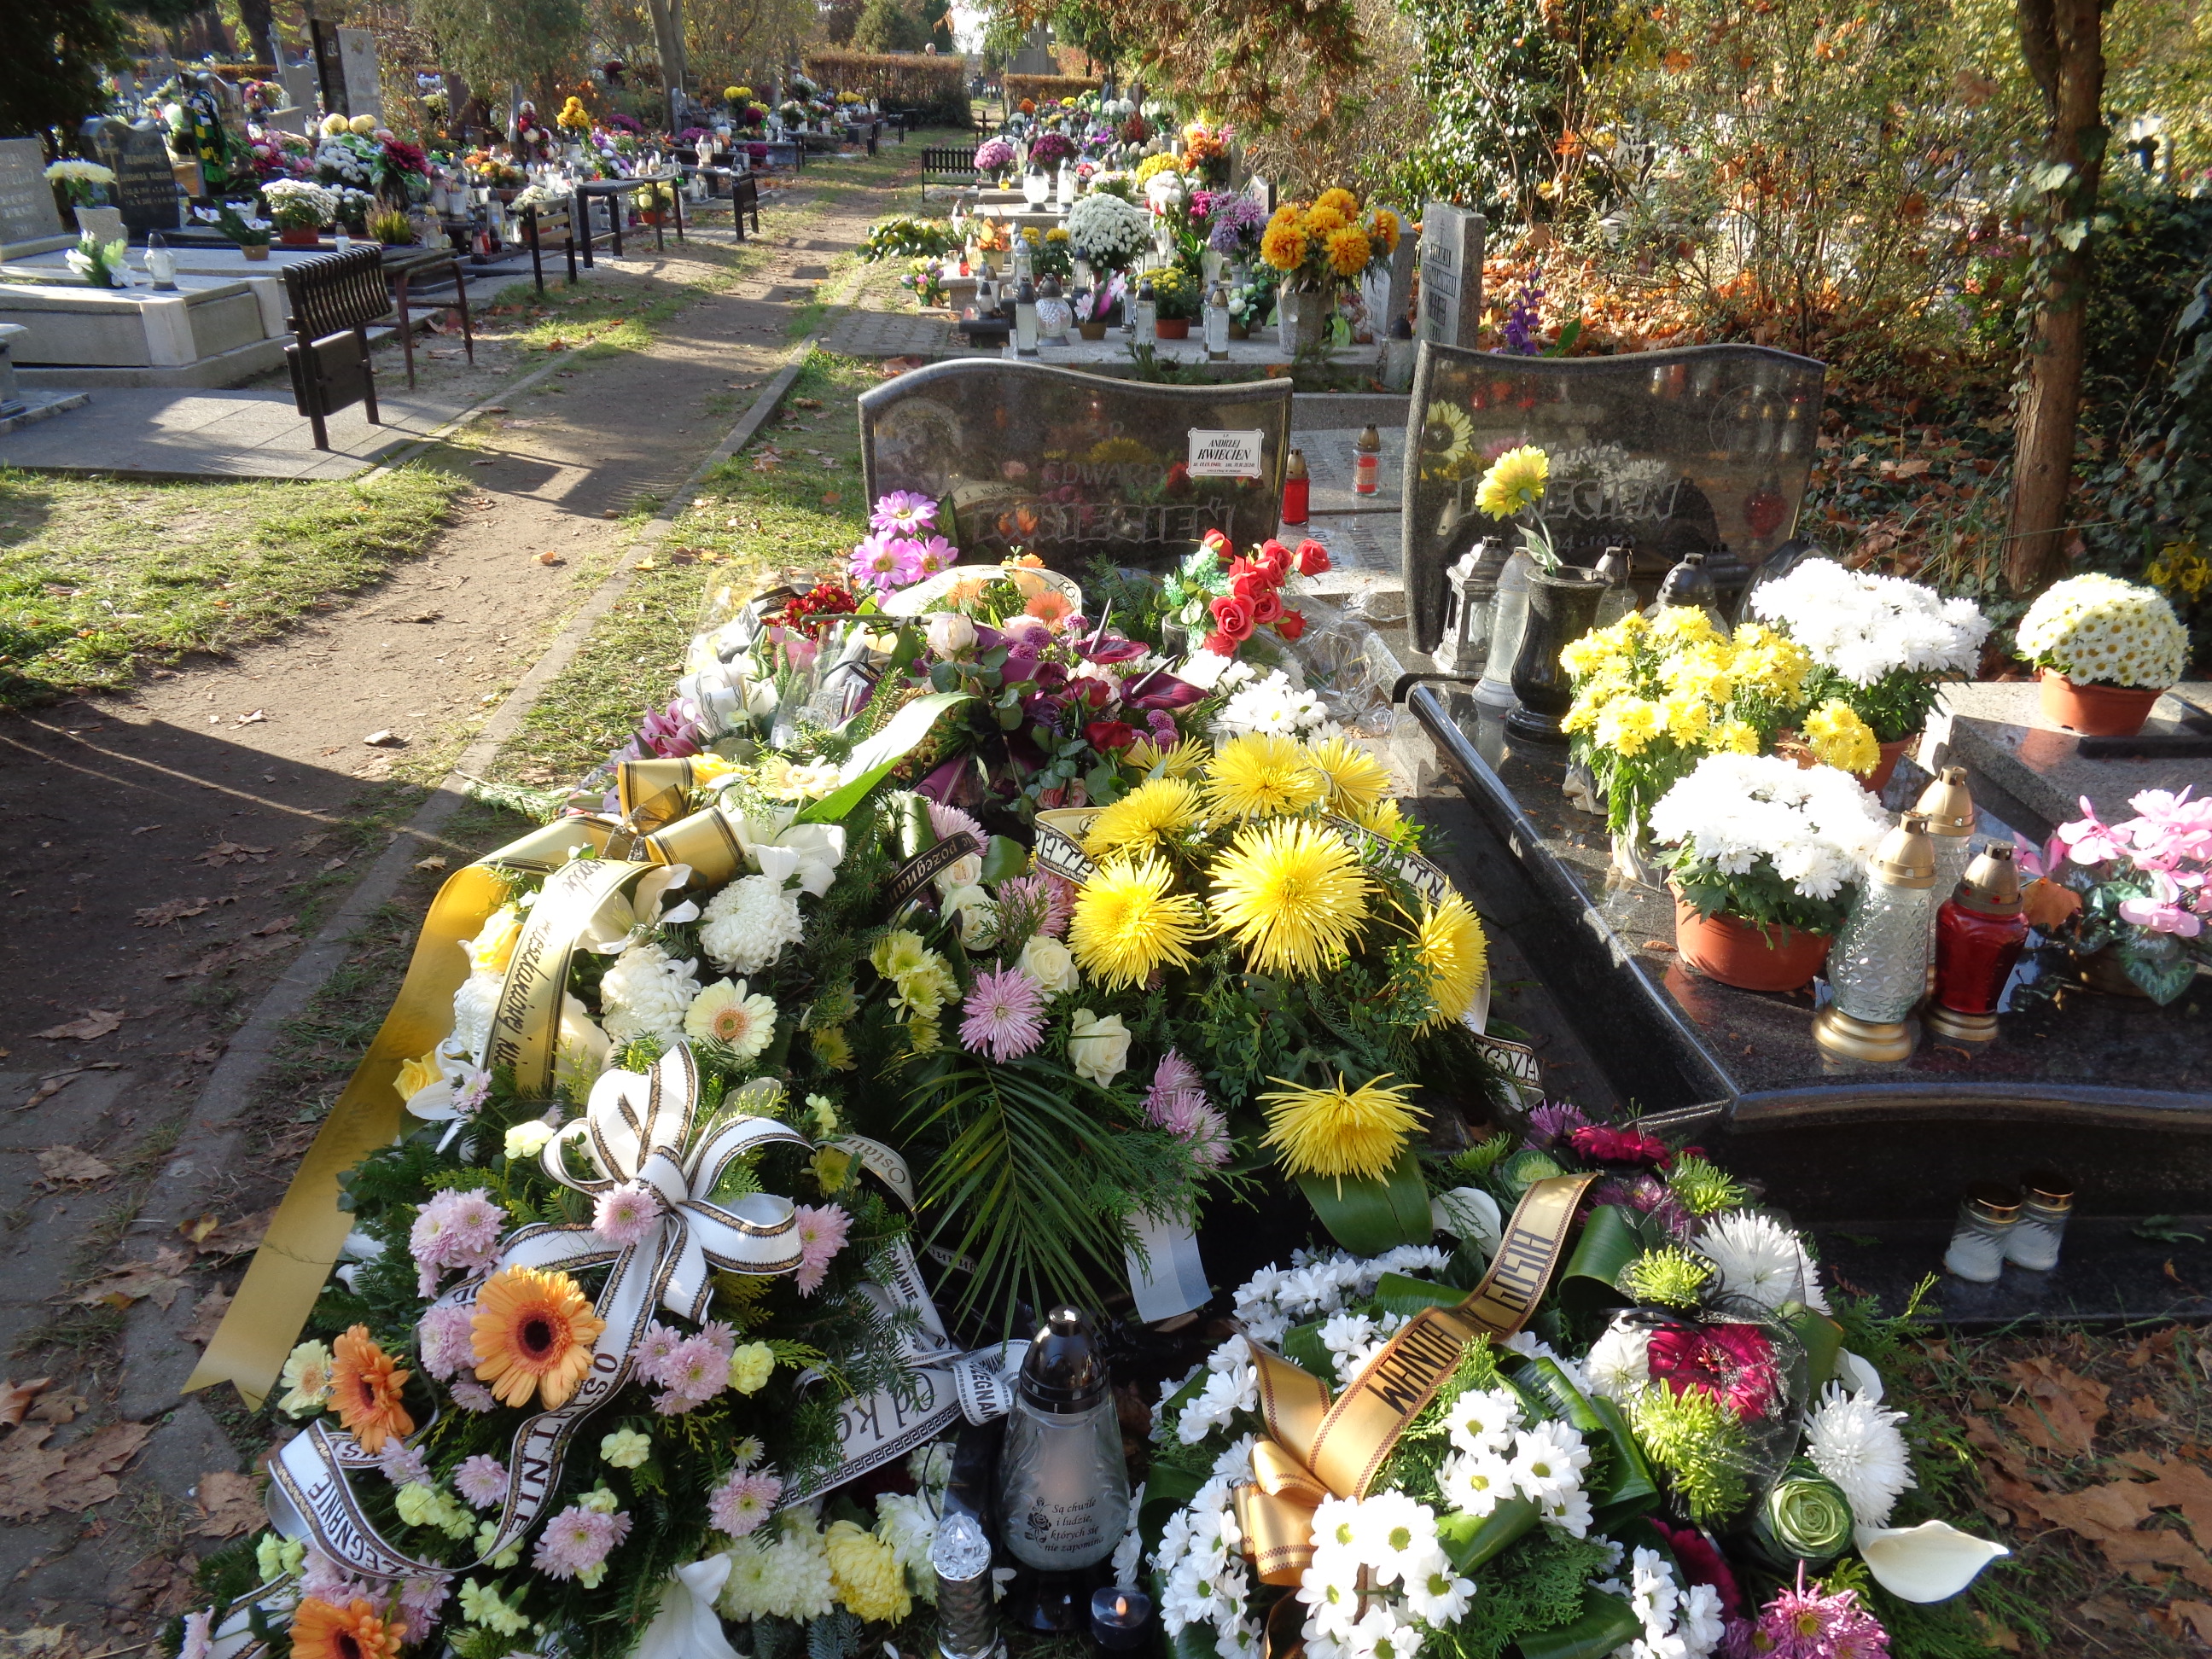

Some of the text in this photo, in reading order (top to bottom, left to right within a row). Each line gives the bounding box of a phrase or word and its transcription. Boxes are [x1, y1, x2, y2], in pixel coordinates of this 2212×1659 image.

[1208, 439, 1241, 449] ANDRZEJ
[1197, 447, 1252, 461] KWIECIEŃ
[1041, 461, 1165, 485] EDWARD
[1365, 1318, 1460, 1417] WANDA
[1481, 1228, 1554, 1314] GOSIA
[512, 1352, 618, 1534] OSTATNIE
[1051, 1496, 1097, 1515] Są chwile
[1057, 1515, 1092, 1527] i ludzie,
[1051, 1524, 1099, 1542] których się
[1045, 1536, 1104, 1553] nie zapomina
